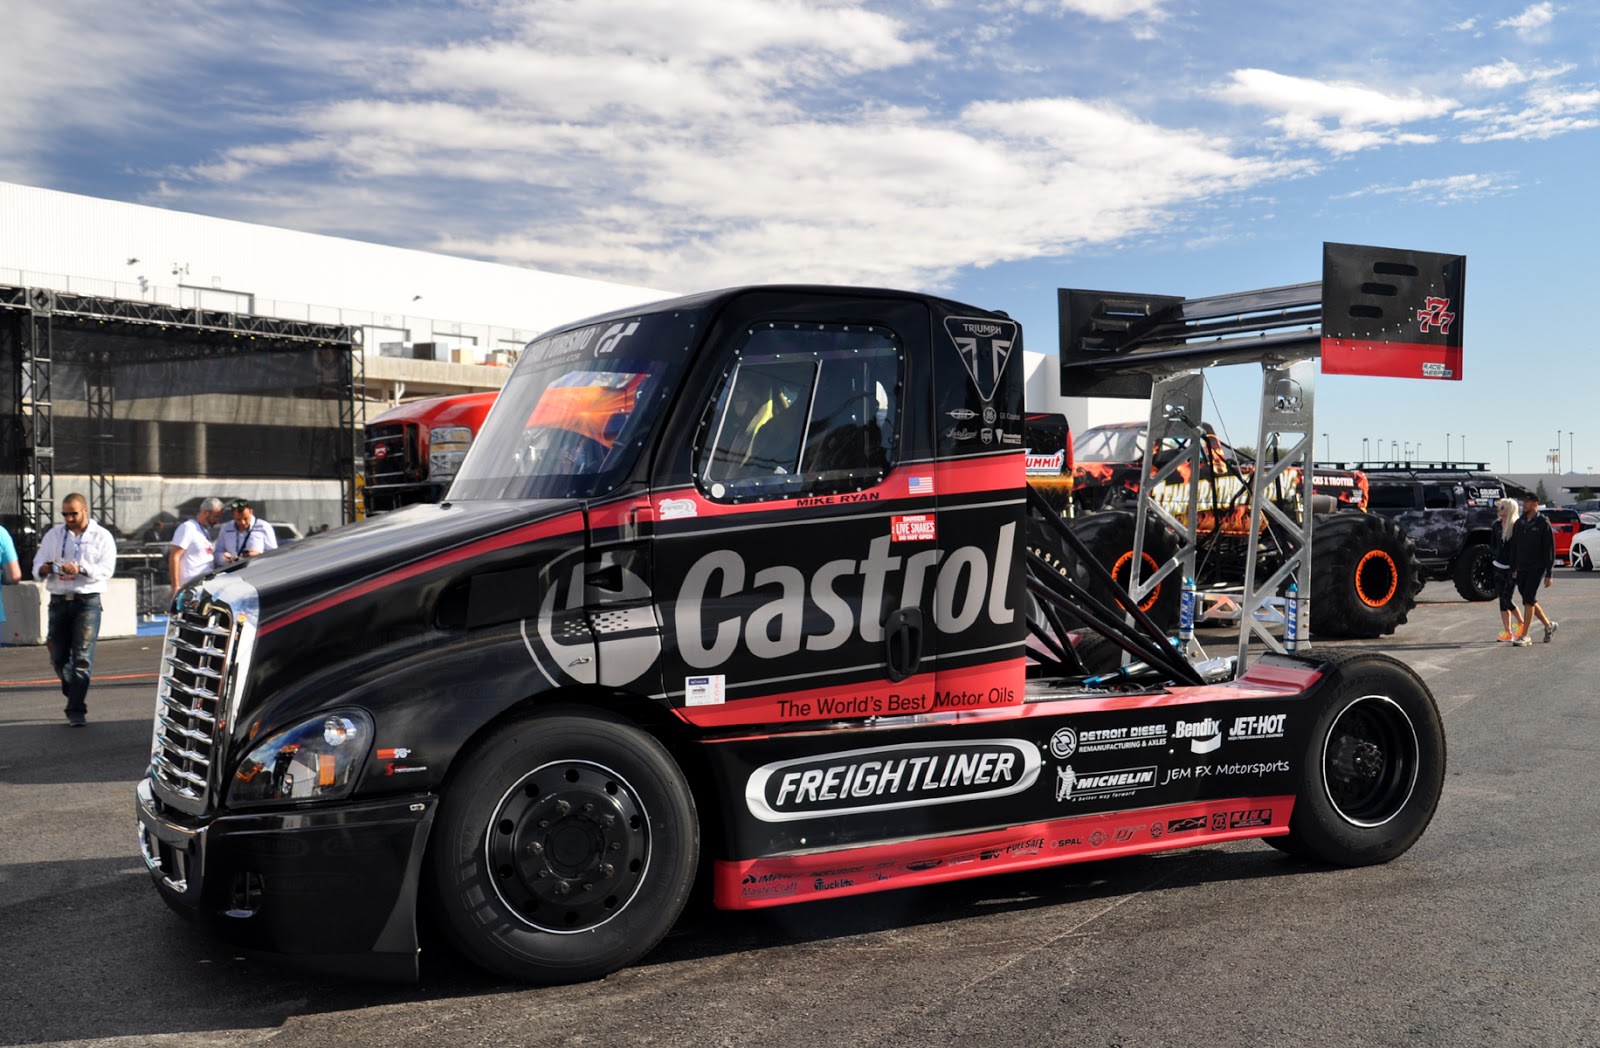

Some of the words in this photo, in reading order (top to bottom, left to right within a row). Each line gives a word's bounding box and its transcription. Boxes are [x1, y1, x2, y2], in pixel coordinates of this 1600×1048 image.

[963, 323, 1002, 337] TRIUMPH
[796, 497, 835, 507] MIKE
[840, 492, 880, 503] RYAN
[896, 523, 910, 534] LIVE
[911, 522, 935, 533] SNAKES
[674, 521, 1016, 669] Castrol
[1288, 598, 1297, 640] KING
[777, 701, 811, 717] The
[817, 696, 883, 715] World's
[888, 694, 926, 712] Best
[934, 691, 984, 708] Motor
[988, 687, 1015, 704] Oils
[1079, 728, 1128, 742] DETROIT
[1130, 724, 1168, 737] DIESEL
[1175, 718, 1221, 739] Bendix
[1229, 714, 1286, 736] JET-HOT
[1078, 741, 1140, 753] REMANUFACTURING
[1148, 738, 1167, 747] AXLES
[775, 752, 1016, 806] FREIGHTLINER
[1076, 771, 1154, 790] MICHELIN
[1160, 767, 1192, 785] JEM
[1195, 765, 1212, 778] FX
[1215, 760, 1290, 778] Motorsports
[1025, 838, 1046, 849] SAFE
[1057, 838, 1083, 847] SPAL
[741, 882, 798, 896] MasterCraft
